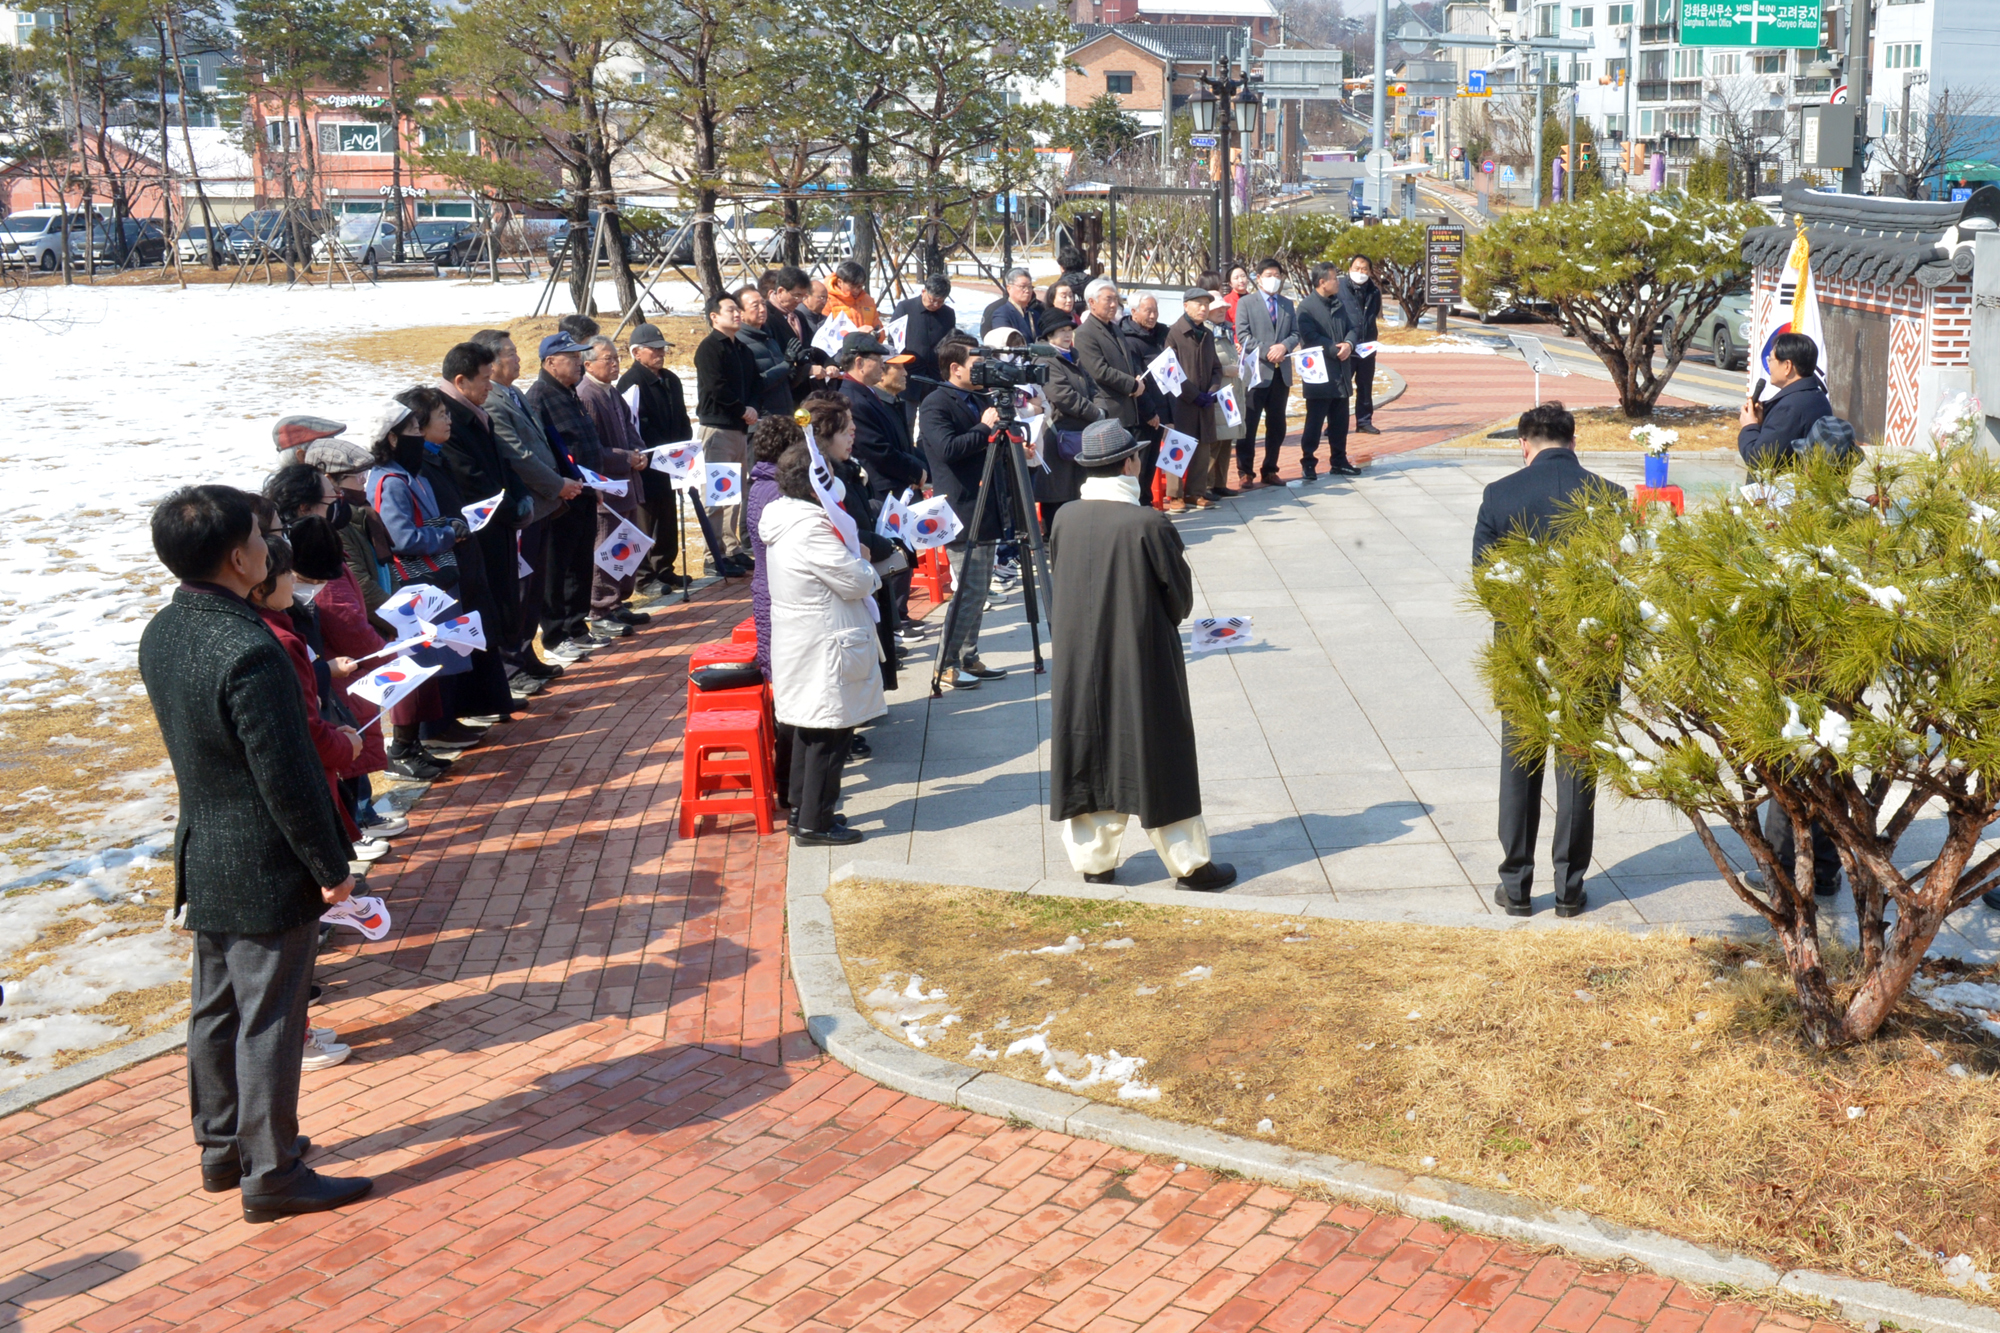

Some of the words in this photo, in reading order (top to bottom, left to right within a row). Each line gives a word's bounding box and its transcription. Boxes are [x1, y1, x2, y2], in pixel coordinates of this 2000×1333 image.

[1684, 3, 1732, 18] 강화읍사무소
[1777, 5, 1818, 19] 고려궁지
[1684, 18, 1704, 28] Ganghwa
[1706, 18, 1718, 27] Town
[1719, 18, 1732, 27] Office
[1777, 19, 1796, 30] Goryeo
[1798, 19, 1817, 29] Palace
